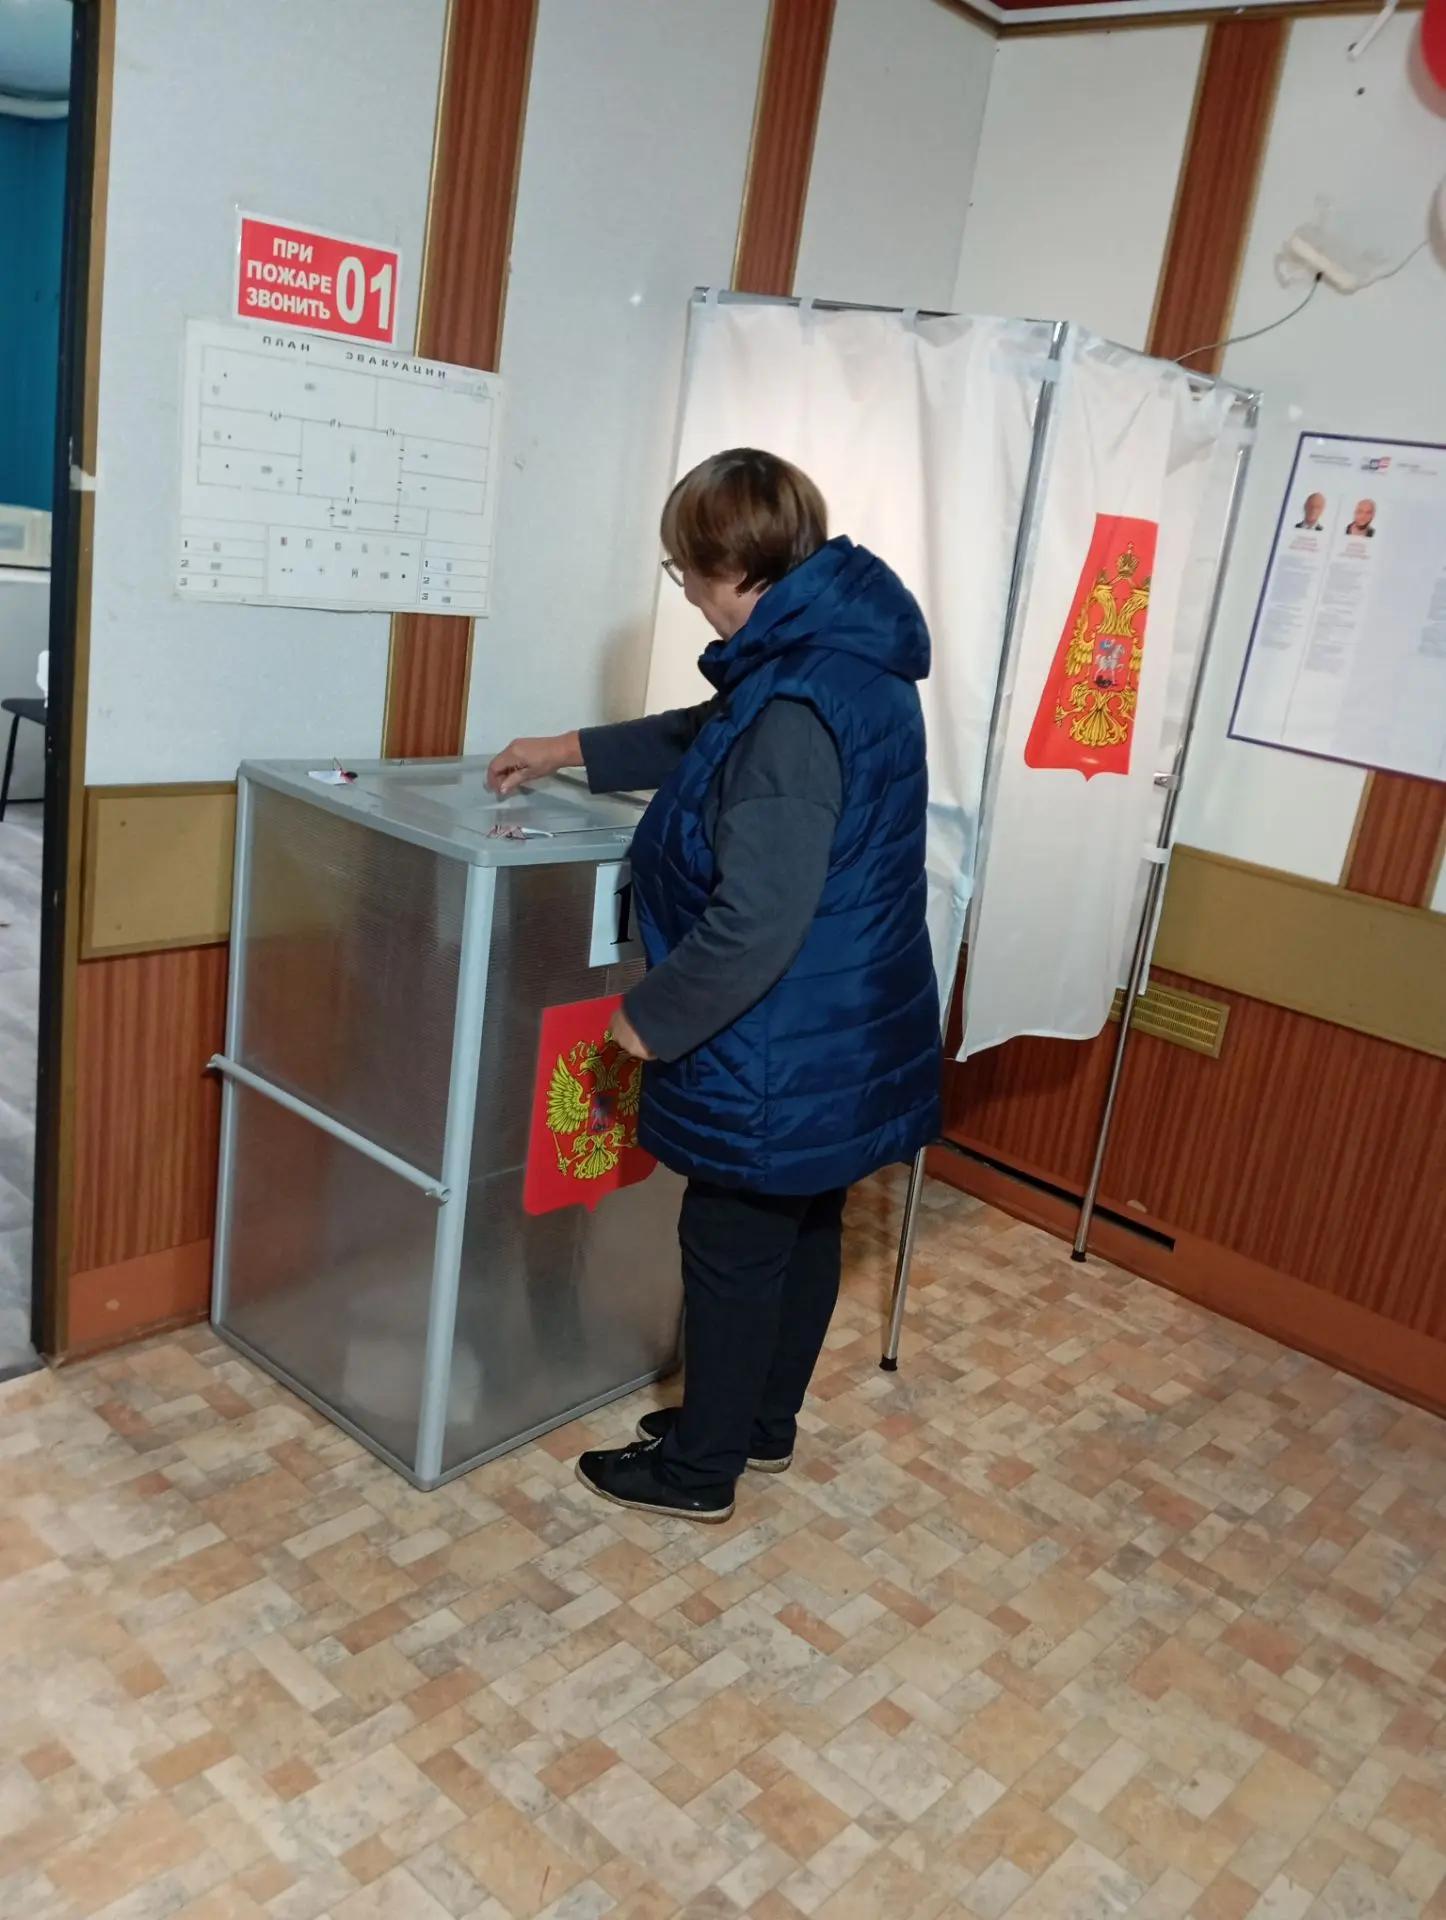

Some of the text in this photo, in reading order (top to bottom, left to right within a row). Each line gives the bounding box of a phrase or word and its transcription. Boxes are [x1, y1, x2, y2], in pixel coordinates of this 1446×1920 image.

[273, 237, 314, 264] ПРИ
[247, 259, 332, 295] ПОЖАРЕ
[336, 256, 393, 331] 01
[246, 286, 331, 320] ЗВОНИТЬ
[262, 335, 447, 380] ПЛАН ЭВАКУАЦИИ
